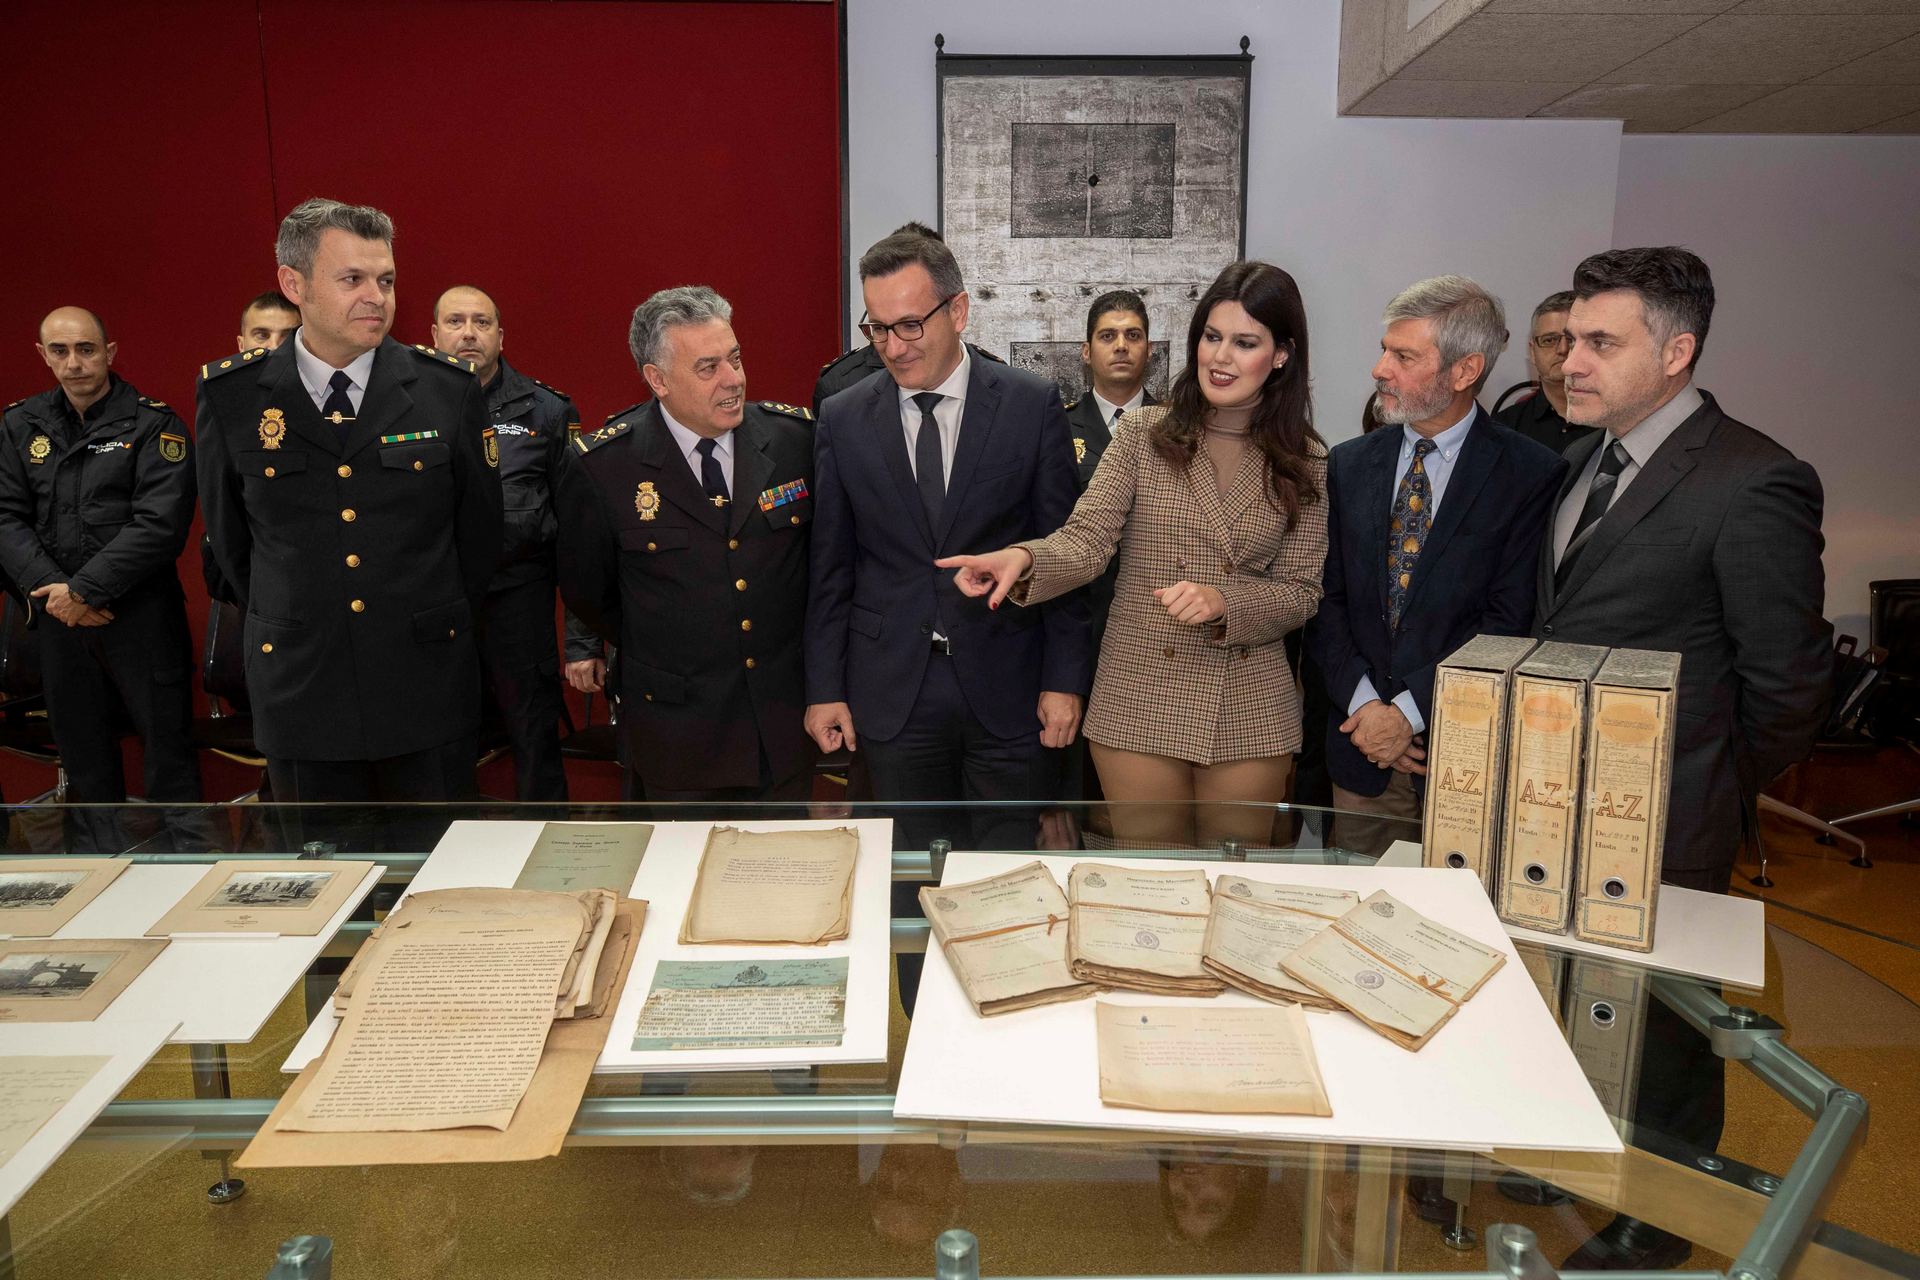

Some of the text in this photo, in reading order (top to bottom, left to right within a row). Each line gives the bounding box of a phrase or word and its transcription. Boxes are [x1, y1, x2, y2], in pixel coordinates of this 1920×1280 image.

[493, 424, 529, 433] POLICIA
[88, 441, 124, 450] POLICIA
[1595, 841, 1617, 851] Hasta
